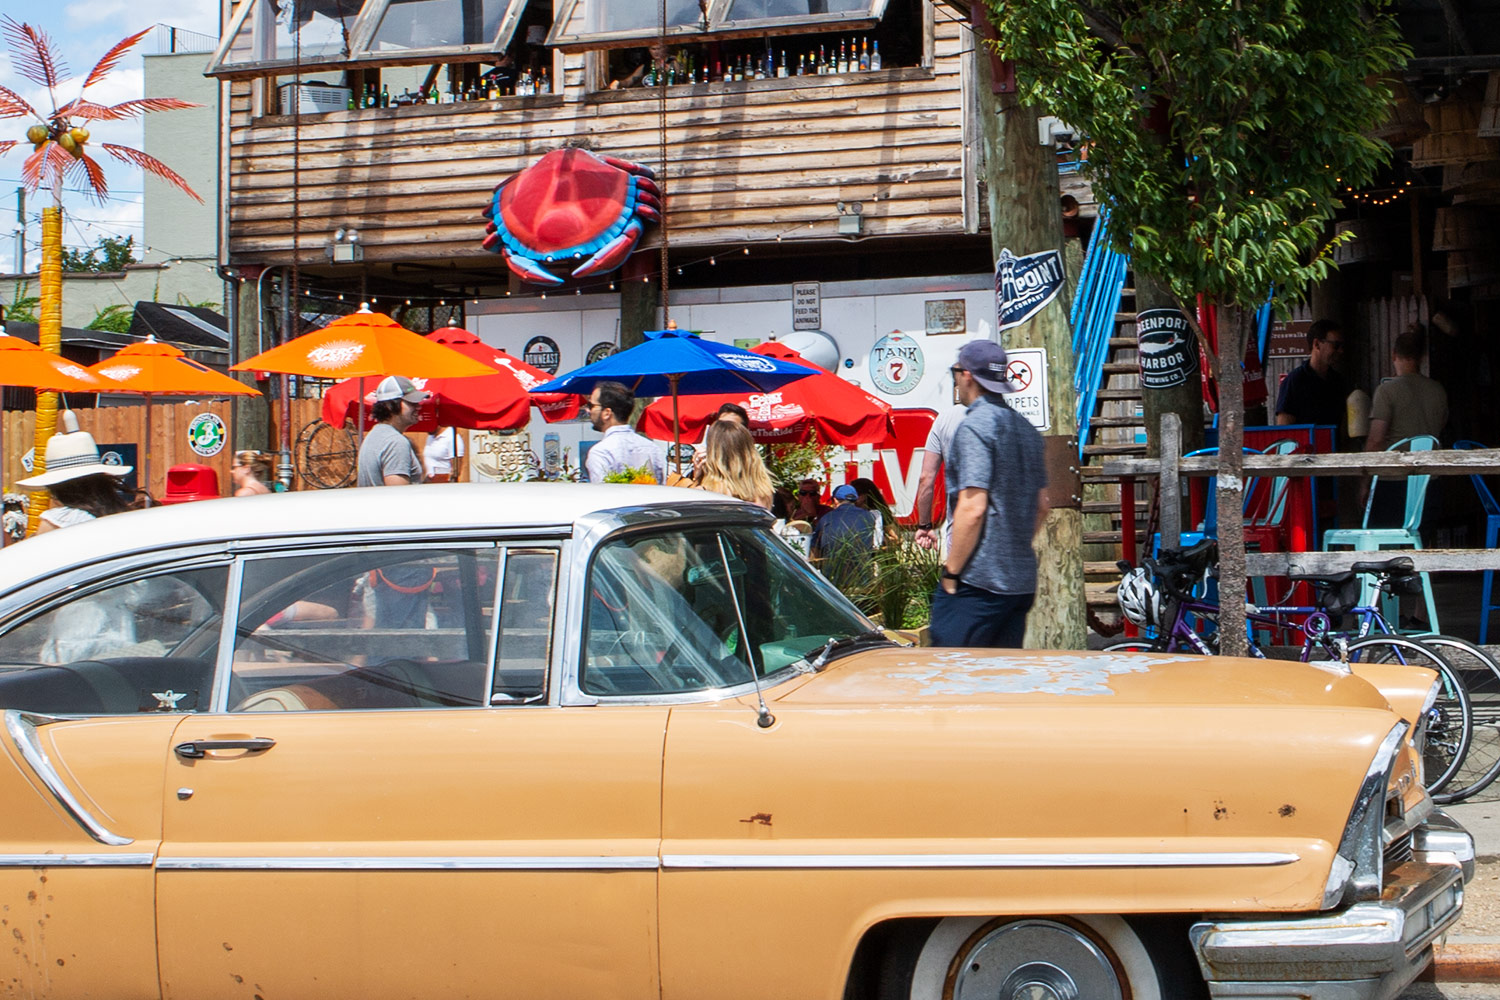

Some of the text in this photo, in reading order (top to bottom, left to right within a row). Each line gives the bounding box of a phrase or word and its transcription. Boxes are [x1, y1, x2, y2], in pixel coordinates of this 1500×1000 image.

[1016, 257, 1060, 291] POINT
[1014, 293, 1045, 310] COMPANY
[1138, 317, 1188, 332] EENPORT
[874, 347, 919, 363] TANK
[1141, 352, 1184, 369] HARBOR
[890, 362, 903, 381] 7
[1015, 396, 1040, 408] PETS
[473, 432, 531, 455] Toasted
